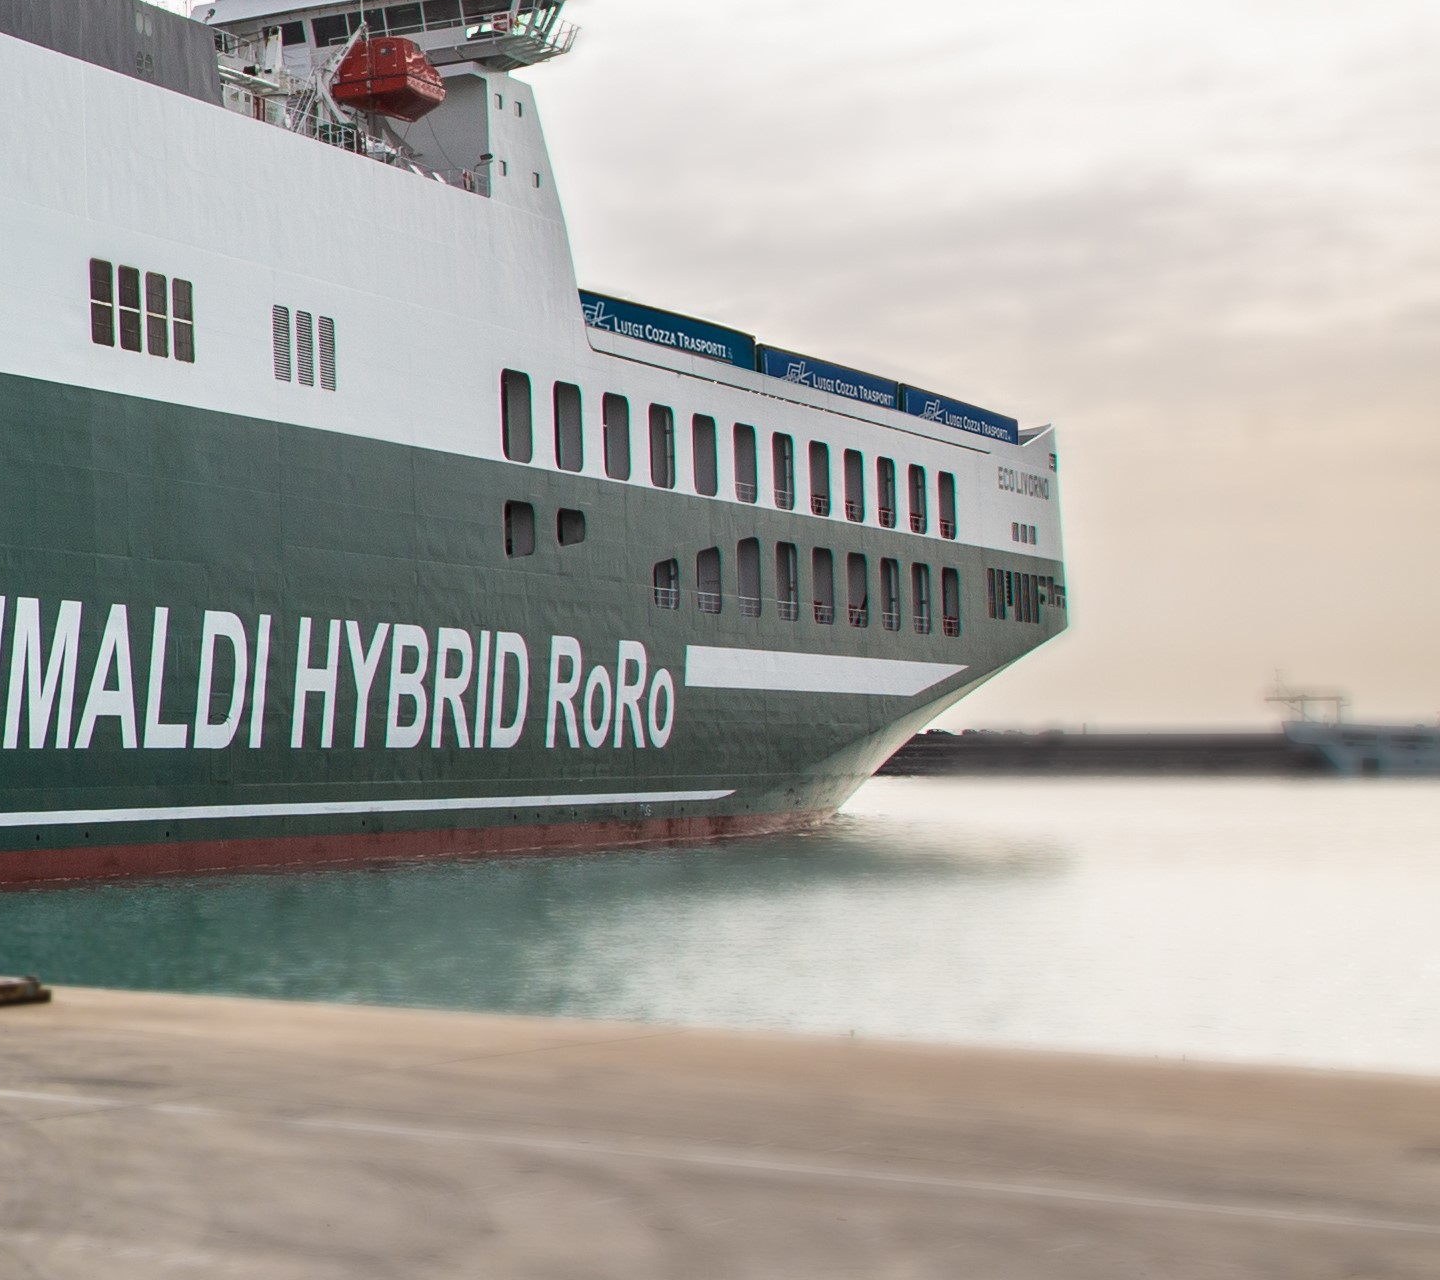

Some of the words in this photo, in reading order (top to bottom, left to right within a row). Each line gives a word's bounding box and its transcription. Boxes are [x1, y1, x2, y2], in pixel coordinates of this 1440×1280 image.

[614, 316, 644, 338] LUIGI
[645, 324, 677, 346] COZZA
[677, 332, 727, 358] TRASPORTI
[290, 615, 529, 750] HYBRID
[545, 634, 675, 750] RoRo
